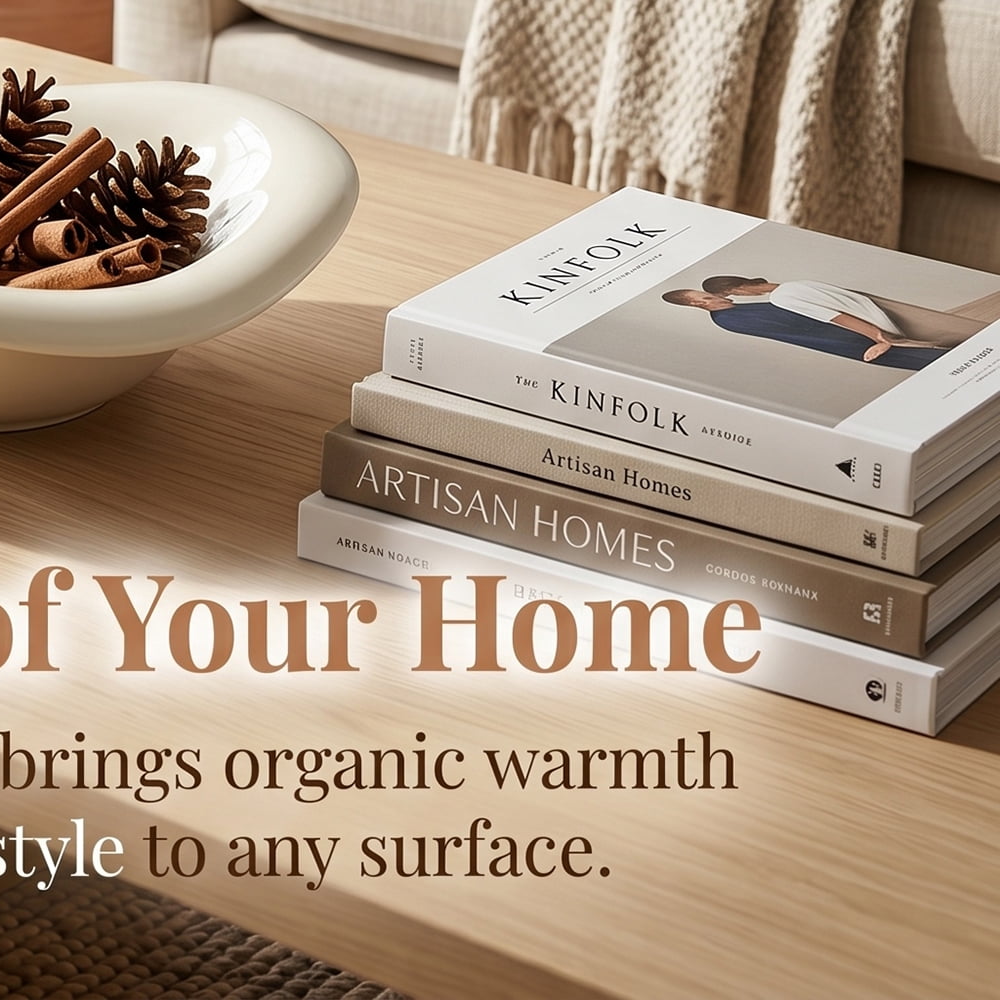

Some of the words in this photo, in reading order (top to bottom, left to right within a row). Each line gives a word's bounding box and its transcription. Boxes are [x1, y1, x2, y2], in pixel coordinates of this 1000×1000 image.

[499, 222, 667, 306] KINFOLK
[551, 379, 690, 437] KINFOLK
[541, 447, 616, 482] Artisan
[622, 467, 693, 501] Homes
[356, 459, 518, 531] ARTISAN
[533, 505, 676, 573] HOMES
